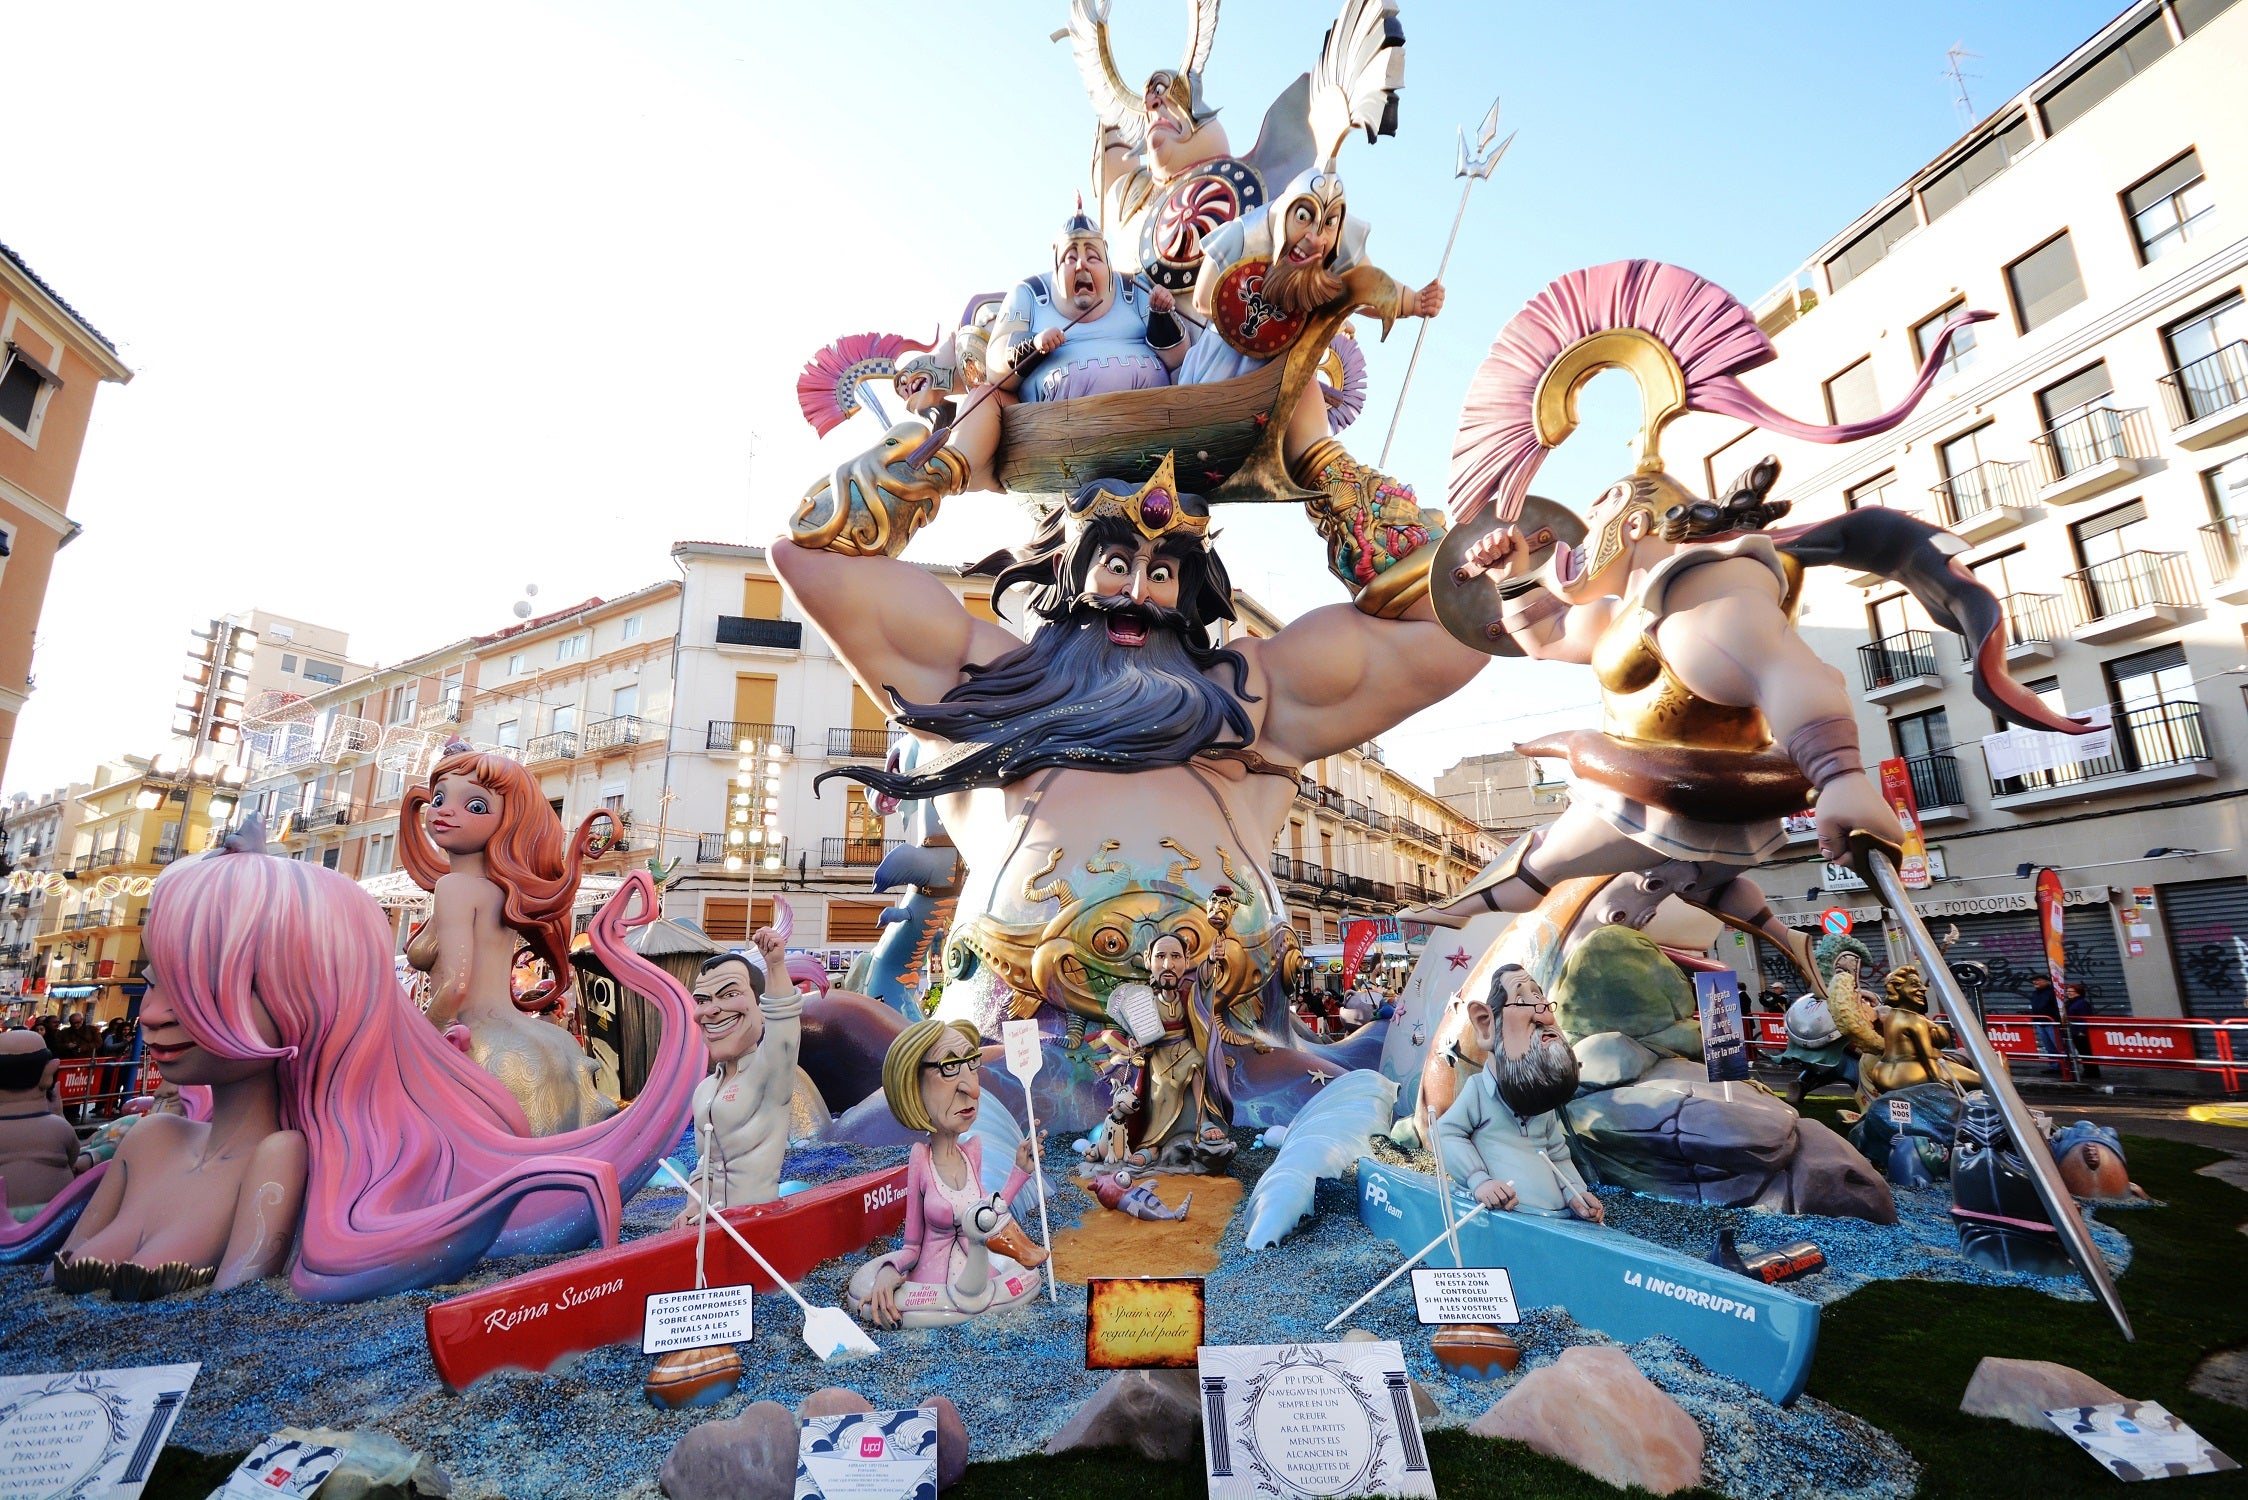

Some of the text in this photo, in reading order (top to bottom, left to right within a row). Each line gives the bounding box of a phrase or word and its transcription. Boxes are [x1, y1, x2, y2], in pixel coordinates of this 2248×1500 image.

[1946, 896, 2027, 914] FOTOCOPIAS
[1801, 914, 1810, 924] DE
[1350, 929, 1373, 969] BAUHAUS
[1725, 1003, 1738, 1013] cup
[1717, 1019, 1732, 1029] vore
[2105, 1031, 2174, 1048] Mahou
[1711, 1049, 1721, 1060] fer
[1721, 1048, 1728, 1057] la
[1891, 1102, 1909, 1110] CASO
[1891, 1110, 1910, 1118] NOOS
[863, 1183, 893, 1214] PSOE
[1365, 1181, 1403, 1219] PP Team
[671, 1293, 706, 1303] PERMET
[708, 1289, 741, 1299] TRAURE
[1623, 1270, 1756, 1323] LA INCORRUPTA
[484, 1278, 624, 1333] Reina Susana
[651, 1298, 748, 1315] FOTOS COMPROMESES
[658, 1310, 740, 1326] SOBRE CANDIDATS
[1110, 1306, 1151, 1323] Spain's
[671, 1325, 702, 1334] RIVALS
[713, 1321, 728, 1330] LES
[1100, 1325, 1190, 1343] regata pel poder
[654, 1335, 701, 1347] PROXIMES
[711, 1330, 742, 1340] MILLES
[1285, 1376, 1295, 1385] PP
[1302, 1375, 1325, 1385] PSOE
[1268, 1388, 1346, 1397] NAVEGAVEN JUNTS
[1278, 1400, 1310, 1409] SEMPRE
[1325, 1399, 1339, 1407] UN
[1293, 1412, 1327, 1420] CREUER
[8, 1420, 95, 1435] AUGURA AL PP
[1280, 1425, 1299, 1433] ARA
[1312, 1423, 1346, 1432] PARTITS
[3, 1435, 84, 1449] UN NAUFRAGI
[863, 1441, 882, 1454] upd
[1289, 1436, 1341, 1446] MENUTS ELS
[1286, 1449, 1348, 1458] ALCANCEN EN
[1287, 1462, 1351, 1472] BARQUETES DE
[1300, 1476, 1341, 1484] LLOGUER
